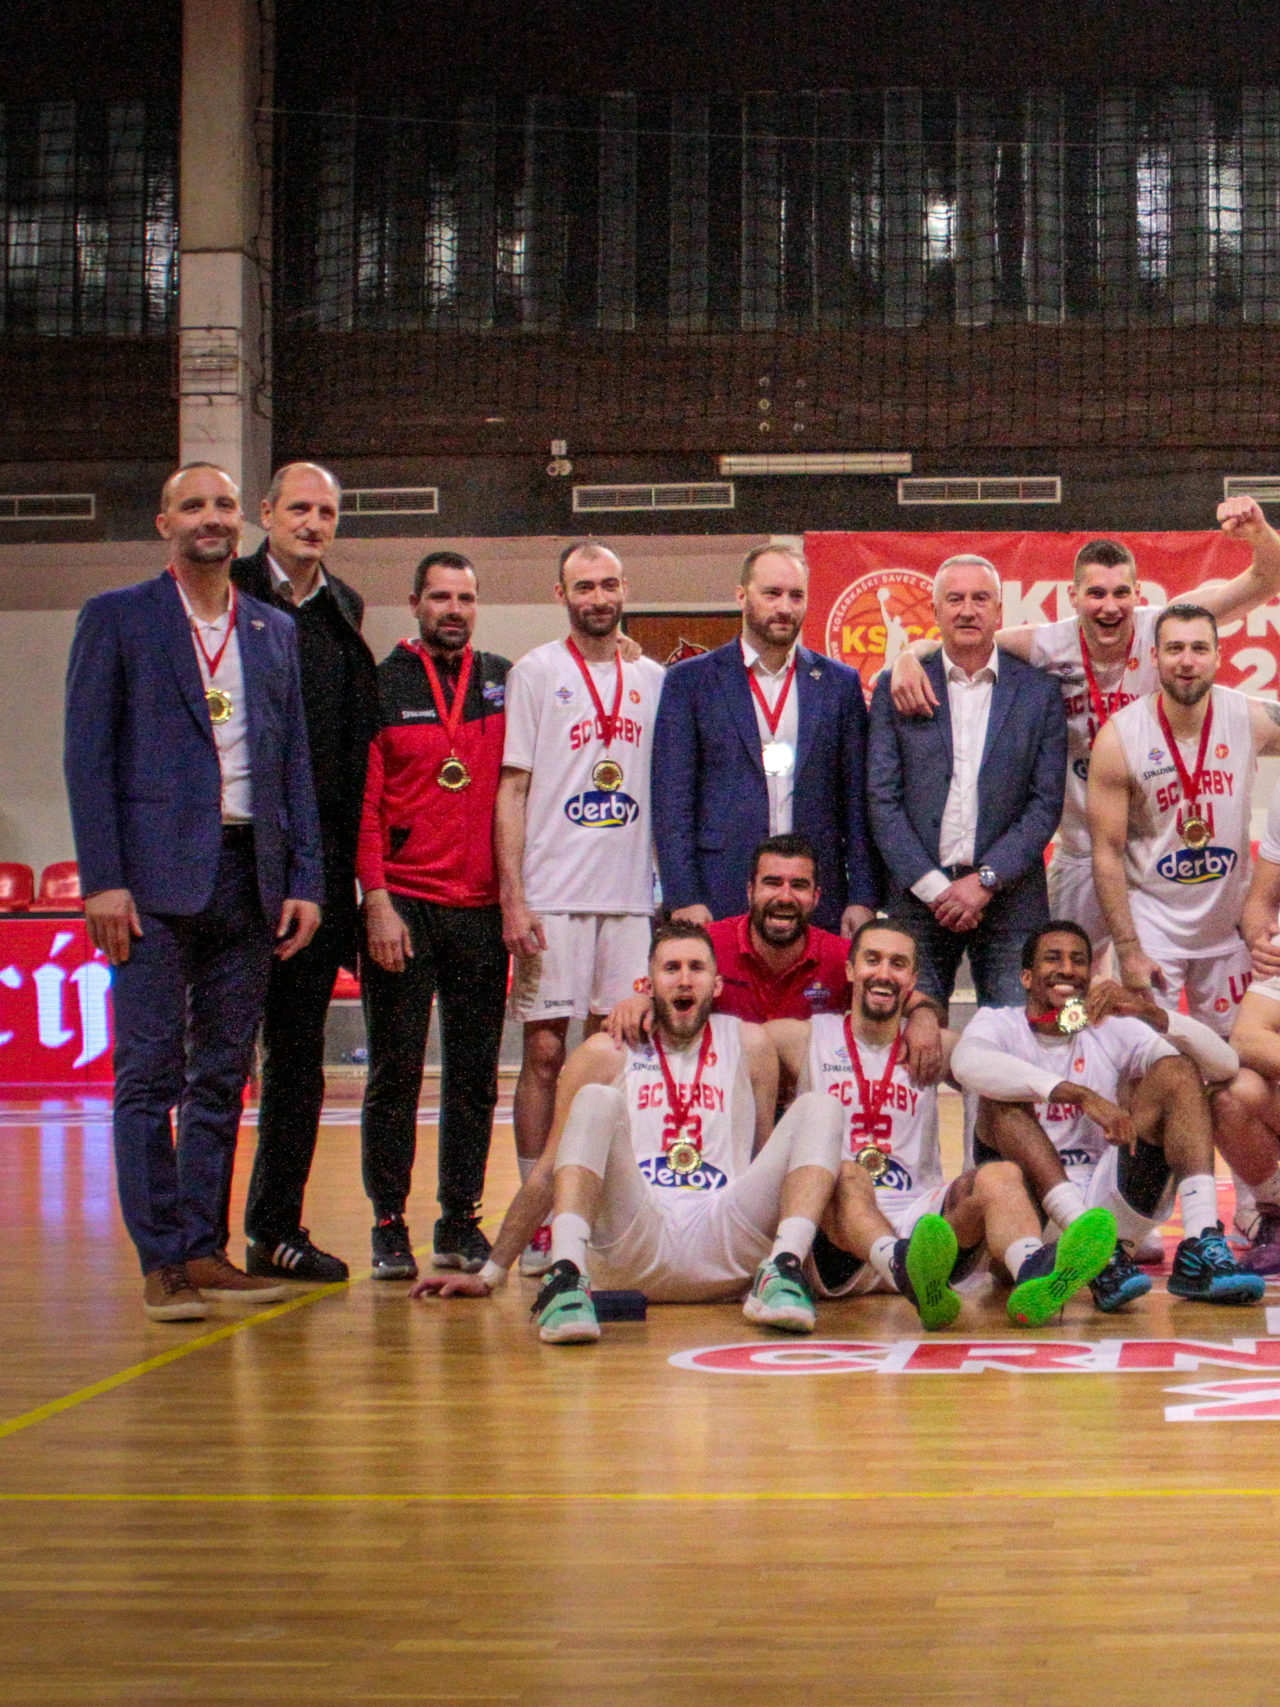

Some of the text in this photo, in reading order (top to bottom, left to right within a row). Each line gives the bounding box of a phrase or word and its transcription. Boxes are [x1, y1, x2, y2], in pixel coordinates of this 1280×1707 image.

[881, 575, 917, 586] SAVEZ
[570, 715, 642, 750] SC DRBY
[1143, 765, 1177, 781] SPALDIN
[1157, 770, 1234, 813] SC ERBY
[567, 793, 638, 827] derby
[1161, 848, 1237, 878] derby
[637, 1082, 724, 1112] SC ERBY
[851, 1113, 893, 1154] 22
